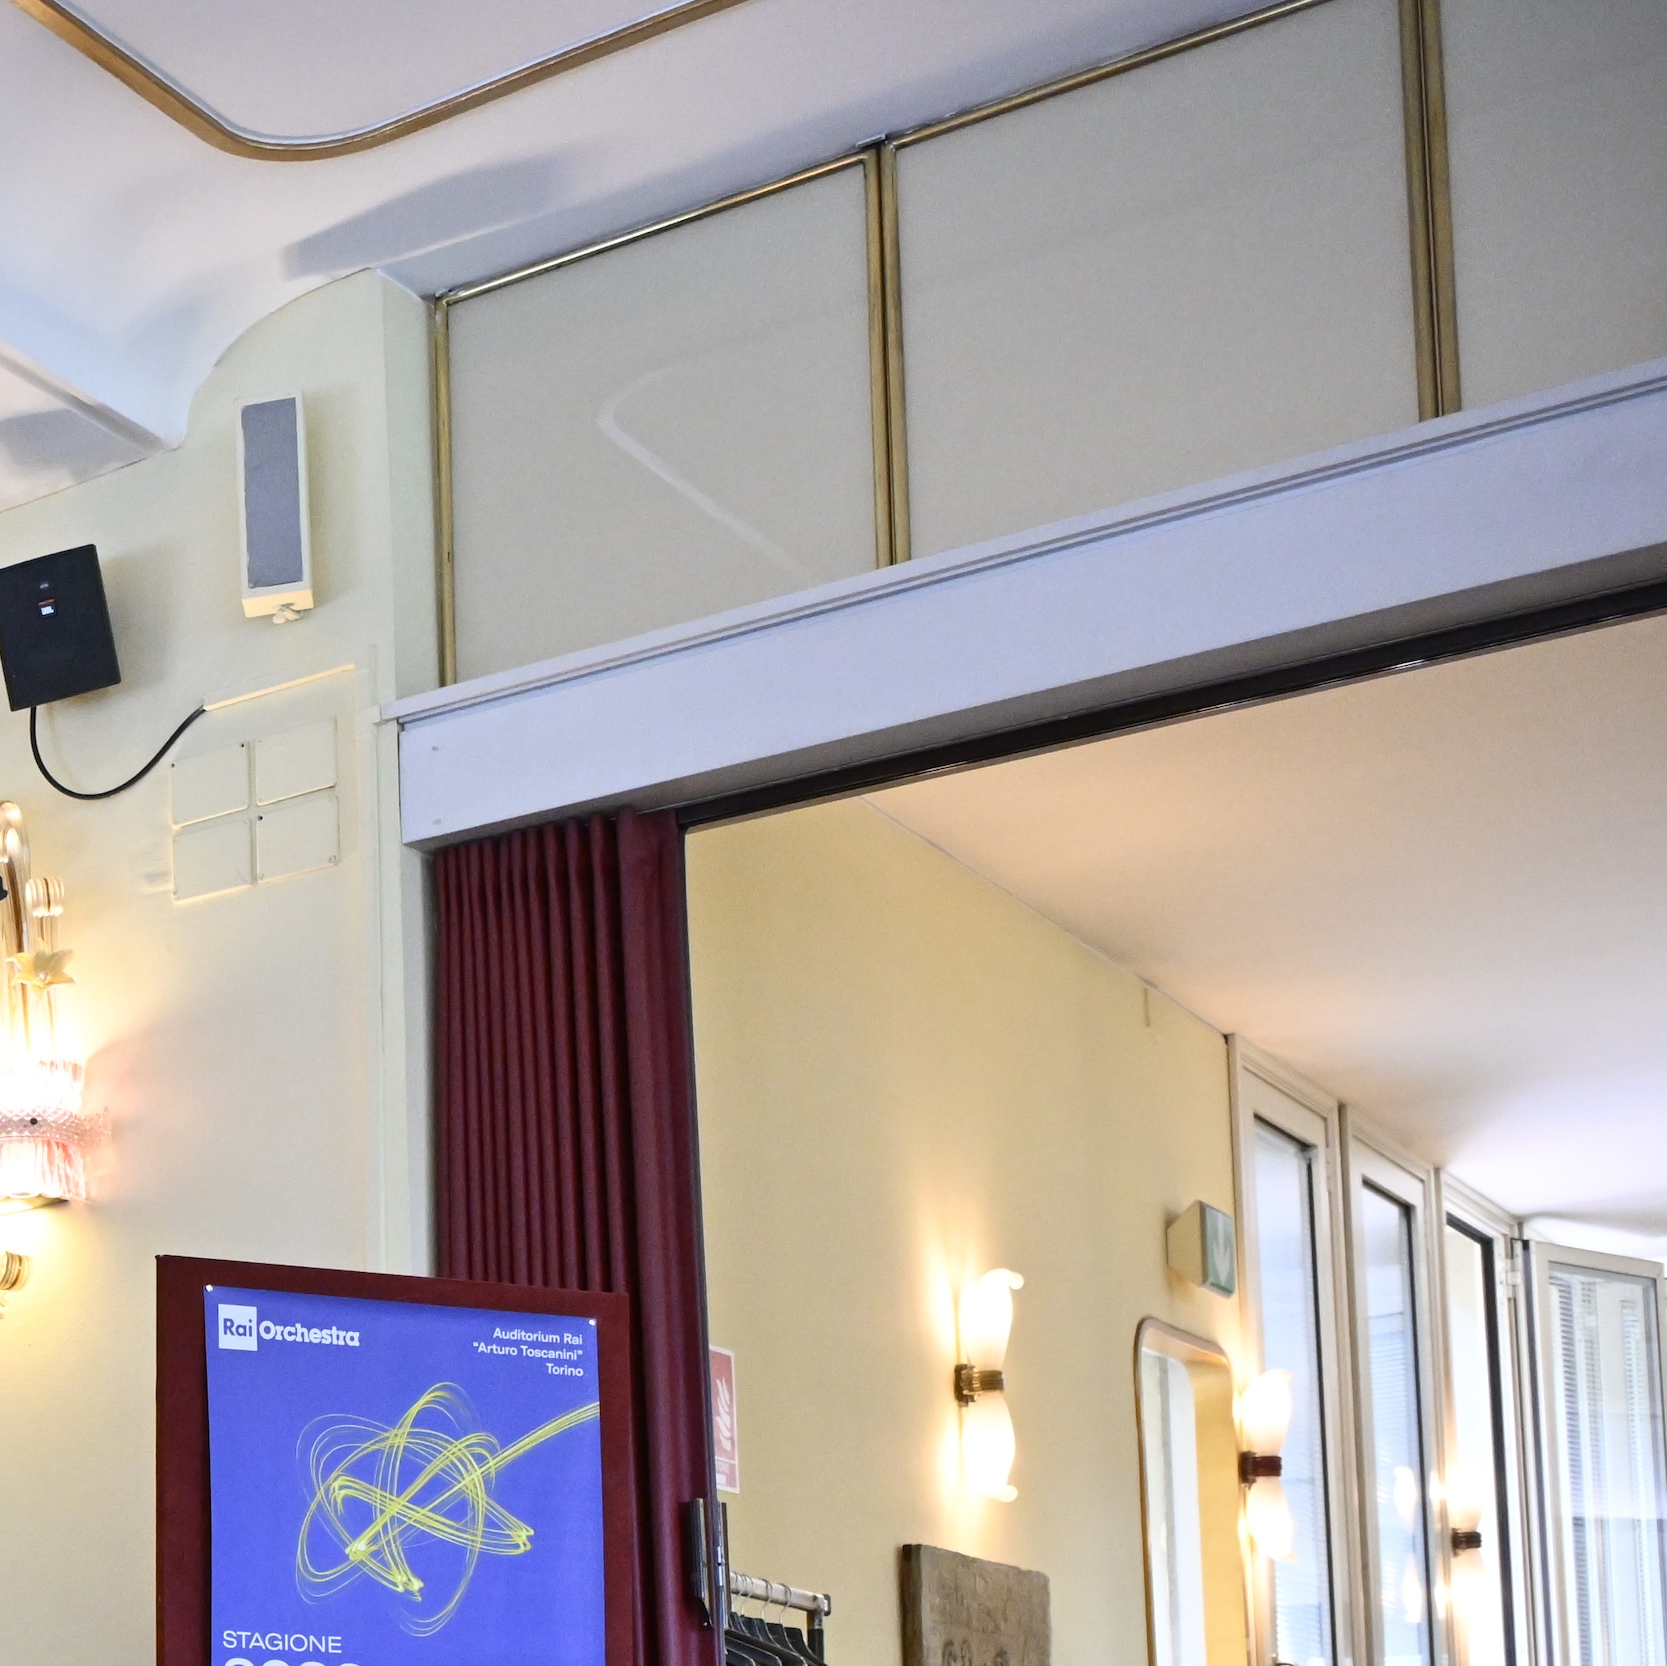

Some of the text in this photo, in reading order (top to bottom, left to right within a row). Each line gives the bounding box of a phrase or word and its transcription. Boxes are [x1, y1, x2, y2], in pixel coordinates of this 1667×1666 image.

[259, 1320, 360, 1347] Orchestra
[493, 1327, 582, 1345] Auditorium Rai
[546, 1363, 584, 1377] Torino
[223, 1630, 342, 1654] STAGIONE
